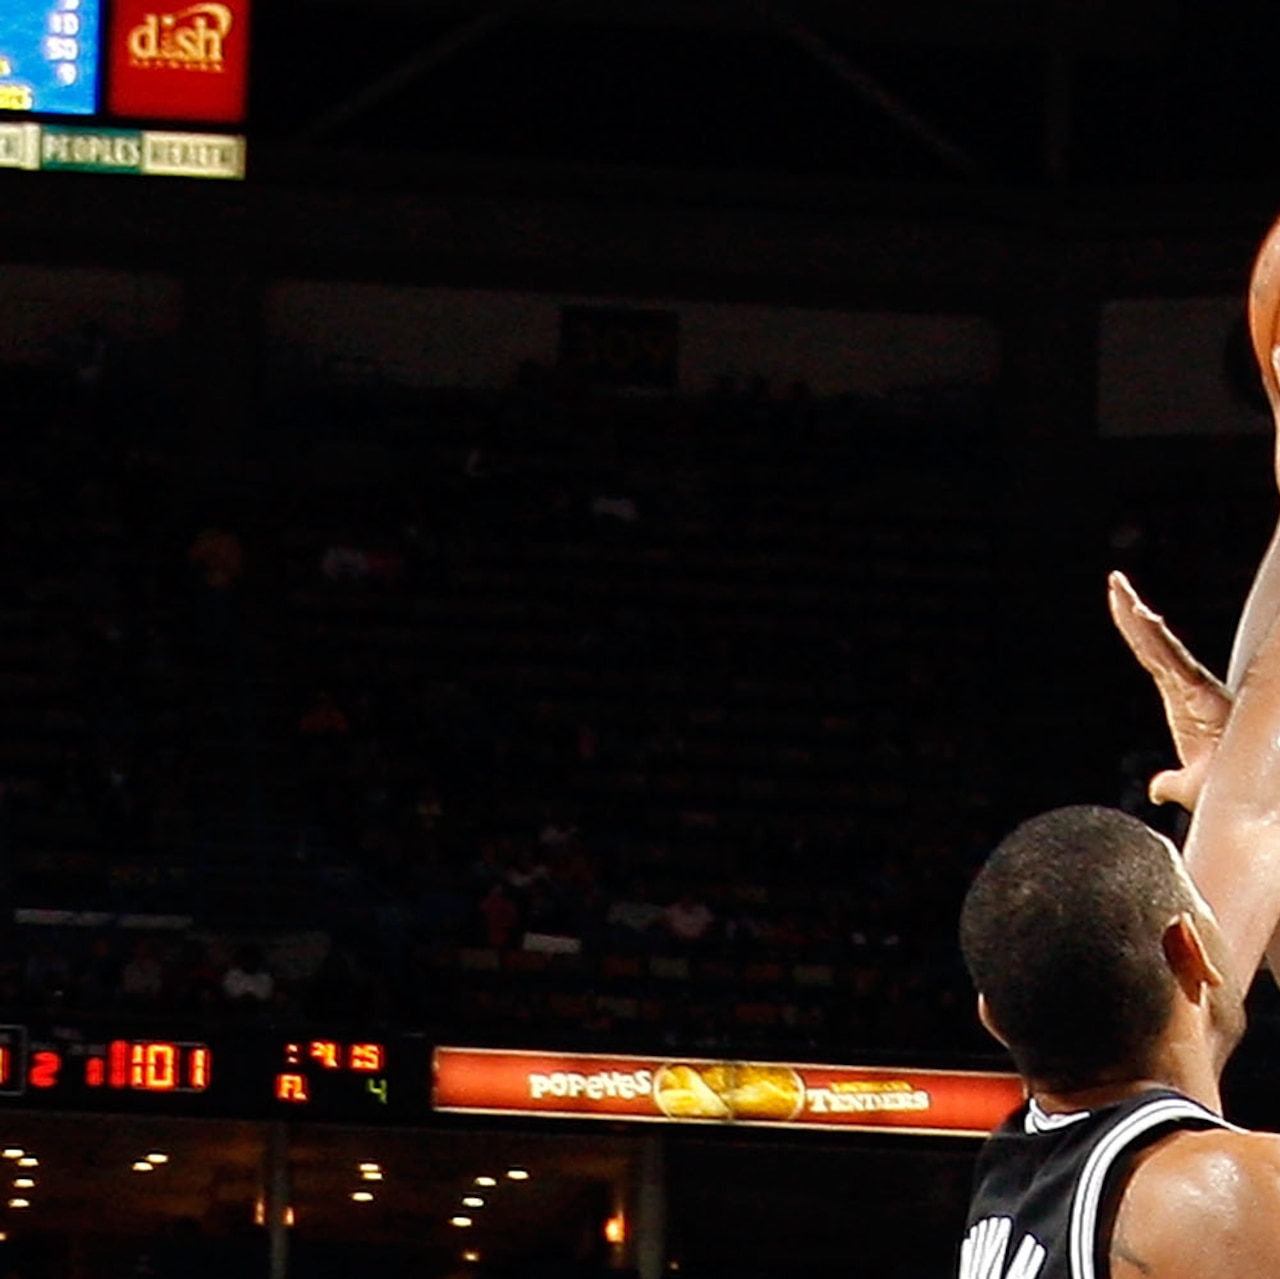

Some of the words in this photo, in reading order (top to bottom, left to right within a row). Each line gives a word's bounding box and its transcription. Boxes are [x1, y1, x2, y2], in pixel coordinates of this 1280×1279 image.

[127, 12, 224, 62] dish
[529, 1069, 652, 1100] POPEYES
[806, 1088, 930, 1113] TENDERS
